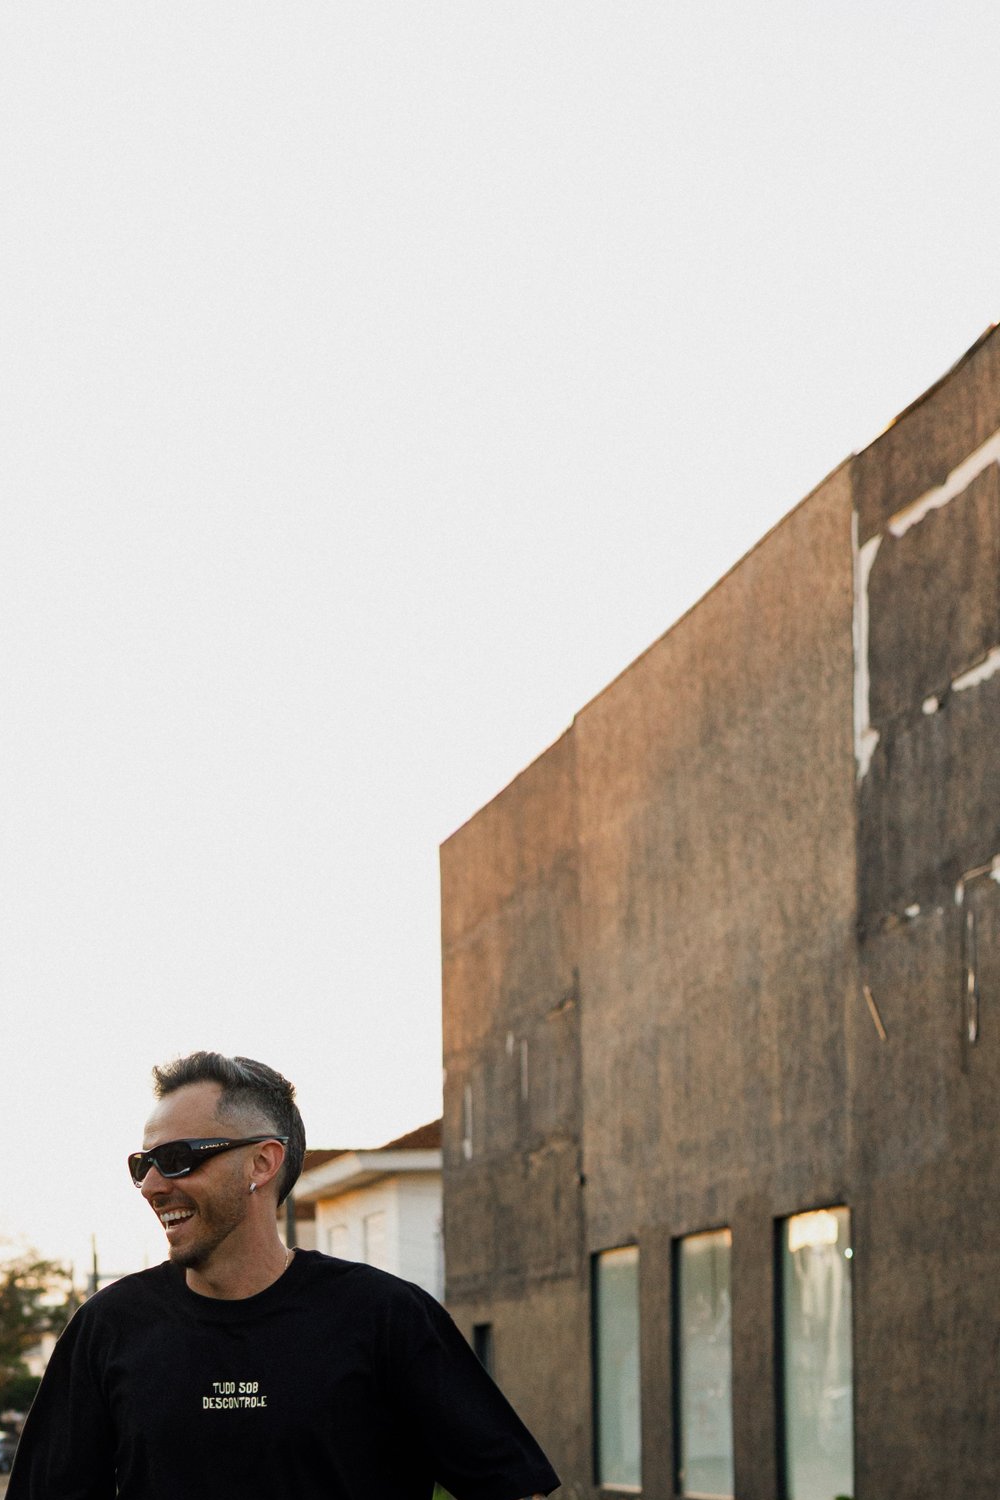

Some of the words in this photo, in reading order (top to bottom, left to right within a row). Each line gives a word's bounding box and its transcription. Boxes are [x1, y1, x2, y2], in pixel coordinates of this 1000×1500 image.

[213, 1382, 235, 1394] TUDO
[238, 1381, 259, 1394] SOB
[202, 1396, 267, 1409] DESCONTROLE
